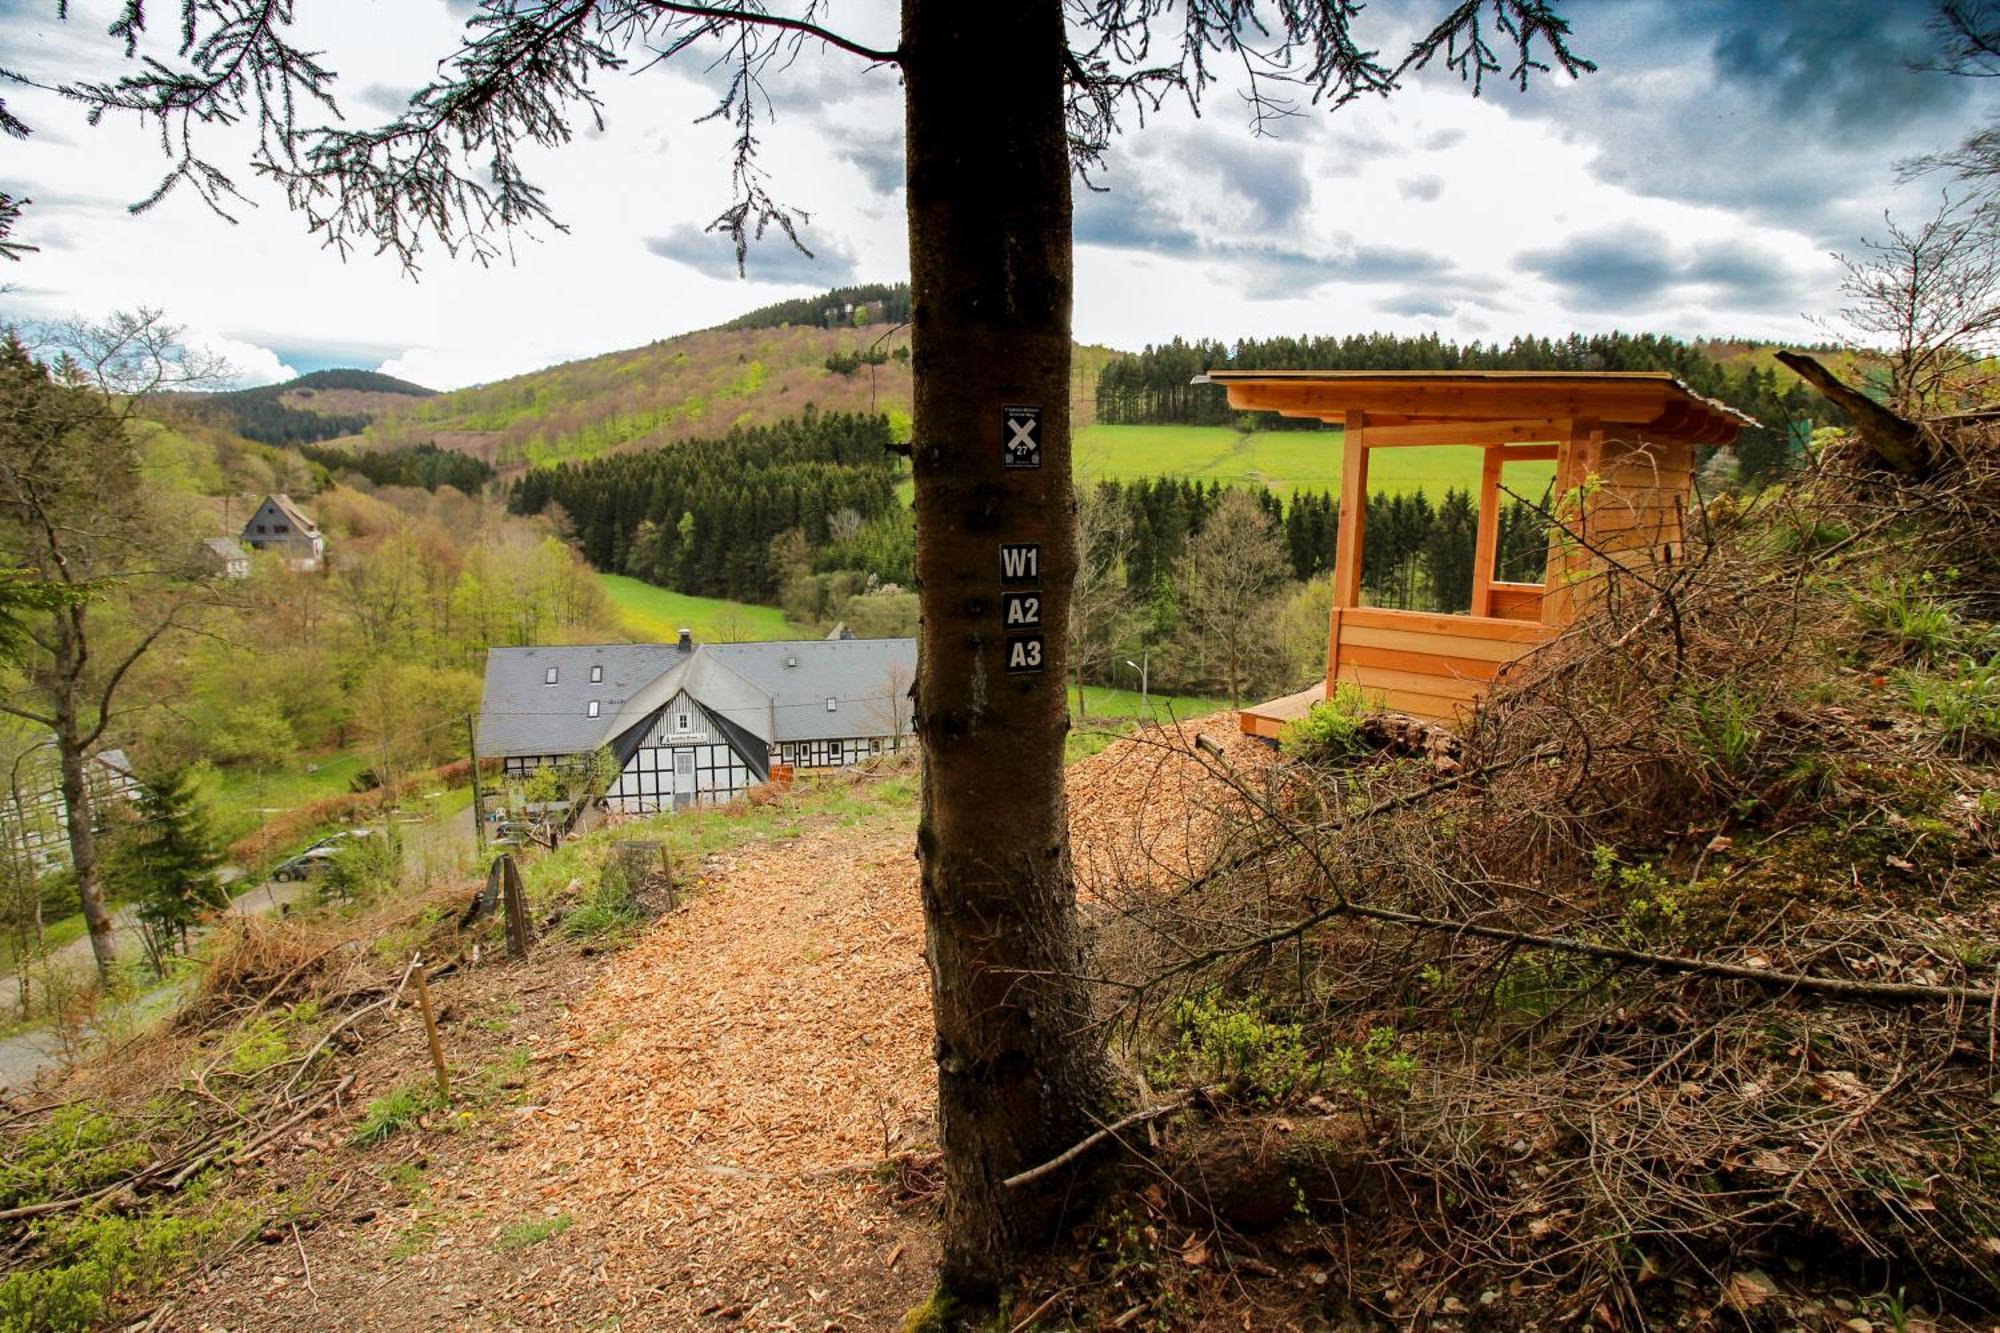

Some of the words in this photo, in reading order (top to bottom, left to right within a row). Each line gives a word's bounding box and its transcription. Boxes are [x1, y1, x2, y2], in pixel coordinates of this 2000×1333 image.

[1016, 446, 1028, 456] 27
[1003, 548, 1037, 577] W1
[1007, 597, 1039, 624] A2
[1010, 640, 1041, 667] A3
